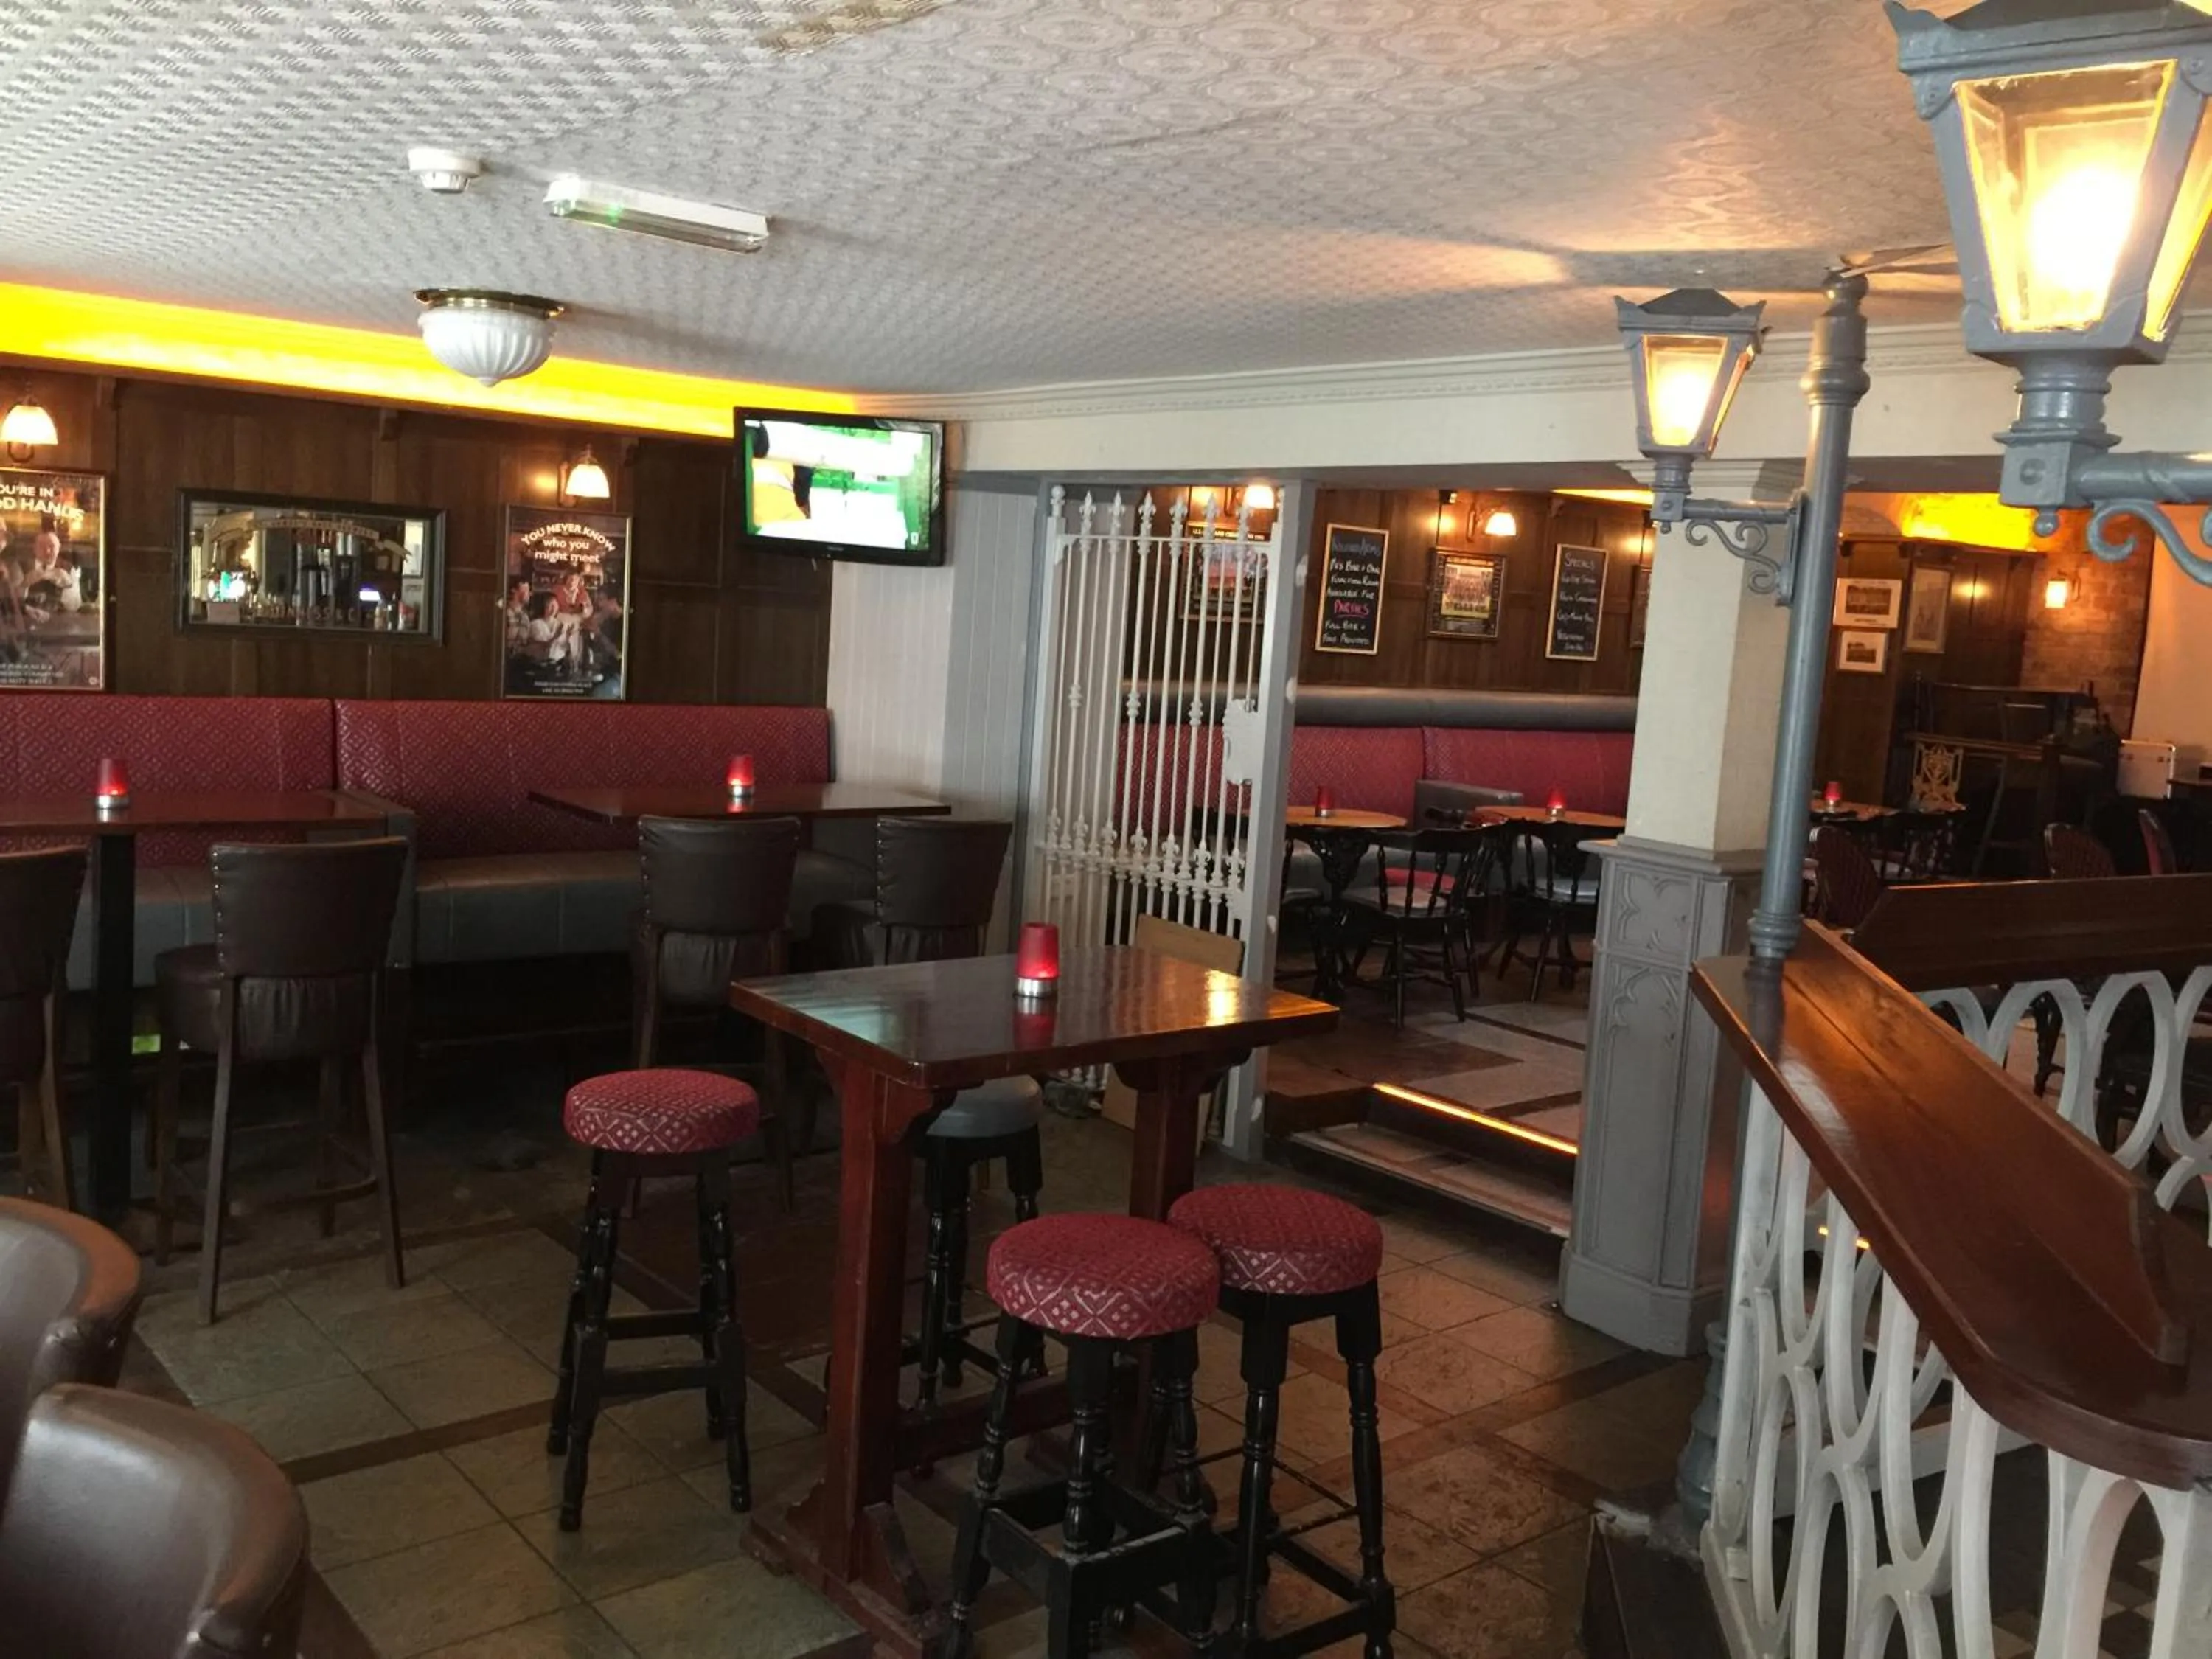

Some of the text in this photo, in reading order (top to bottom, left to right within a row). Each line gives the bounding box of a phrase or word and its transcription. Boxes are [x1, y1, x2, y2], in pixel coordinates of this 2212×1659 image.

[39, 487, 54, 498] IN
[21, 498, 85, 521] HANDS
[521, 523, 616, 552] YOU NEVER KNOW
[543, 537, 589, 551] who you
[535, 549, 600, 563] might meet
